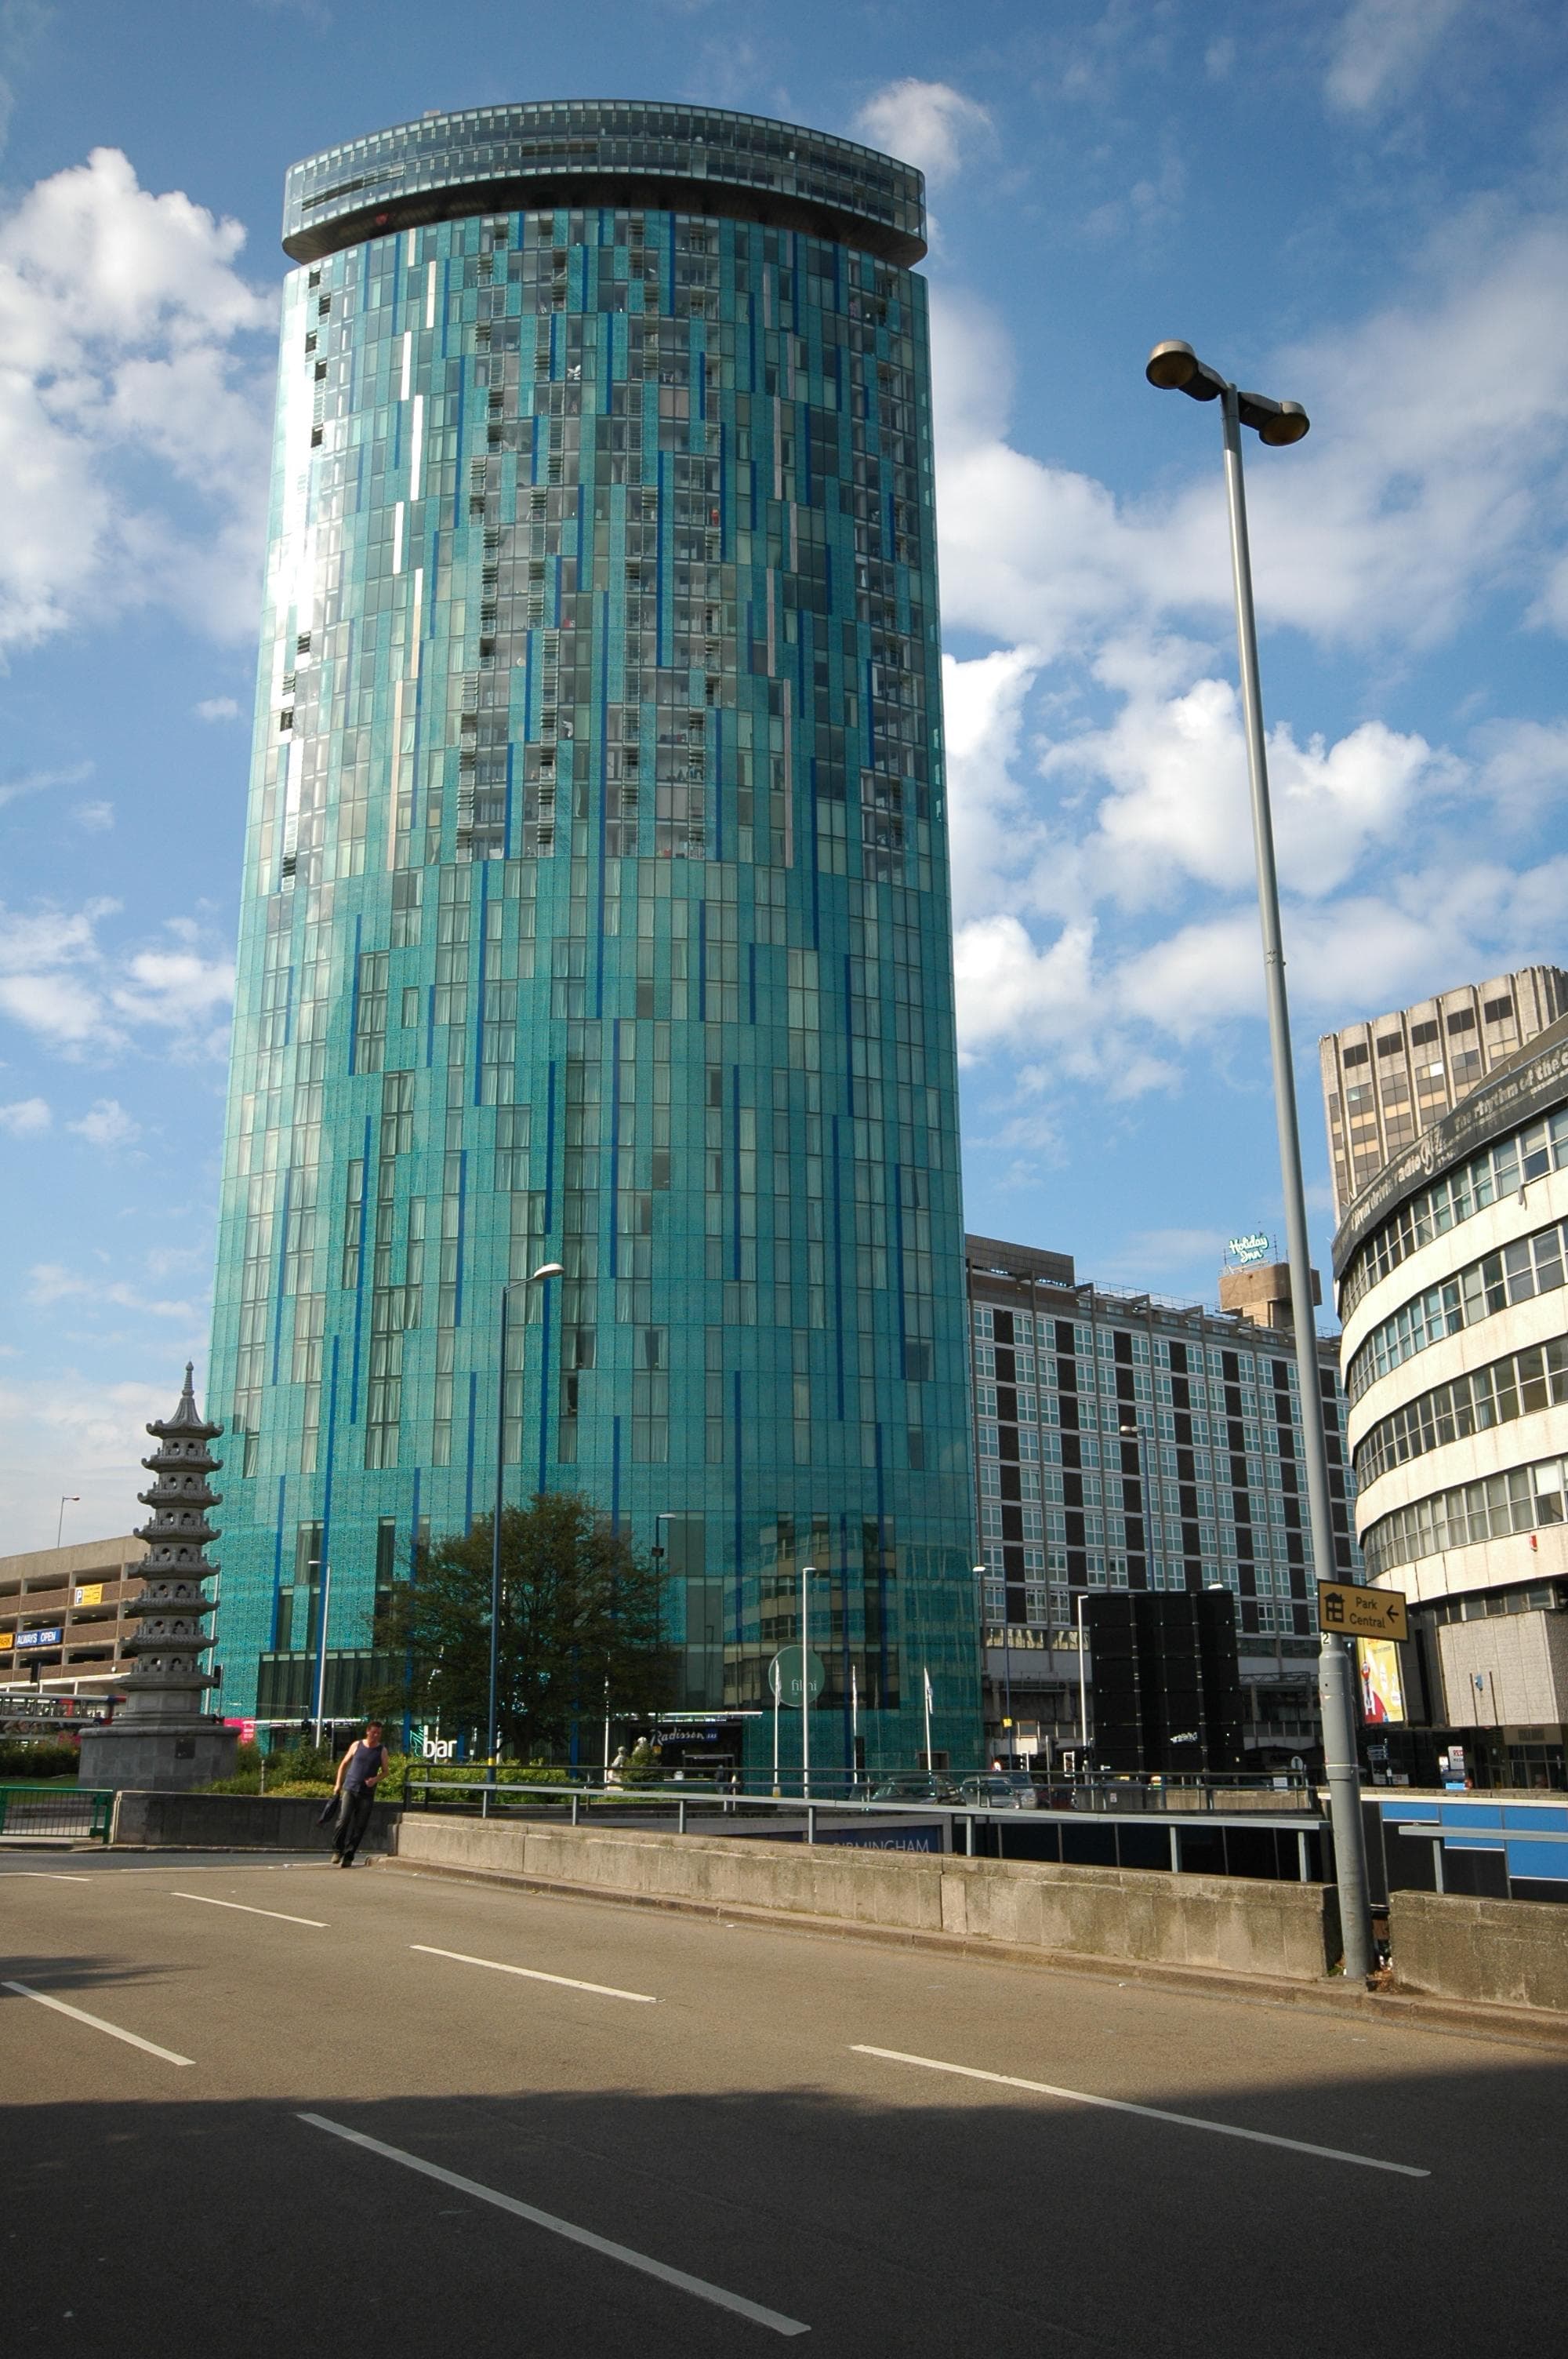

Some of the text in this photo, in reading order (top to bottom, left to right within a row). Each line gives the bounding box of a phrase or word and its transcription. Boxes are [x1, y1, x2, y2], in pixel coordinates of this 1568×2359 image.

[1536, 1052, 1559, 1081] the
[1393, 1154, 1421, 1187] radio
[1229, 1234, 1269, 1255] Holiday
[1240, 1249, 1263, 1263] Inn
[1356, 1597, 1378, 1610] Park
[1349, 1612, 1386, 1629] Central
[17, 1631, 56, 1645] ALWAYS OPEN
[792, 1679, 817, 1691] filni
[423, 1725, 458, 1757] bar
[649, 1727, 705, 1747] Radisson
